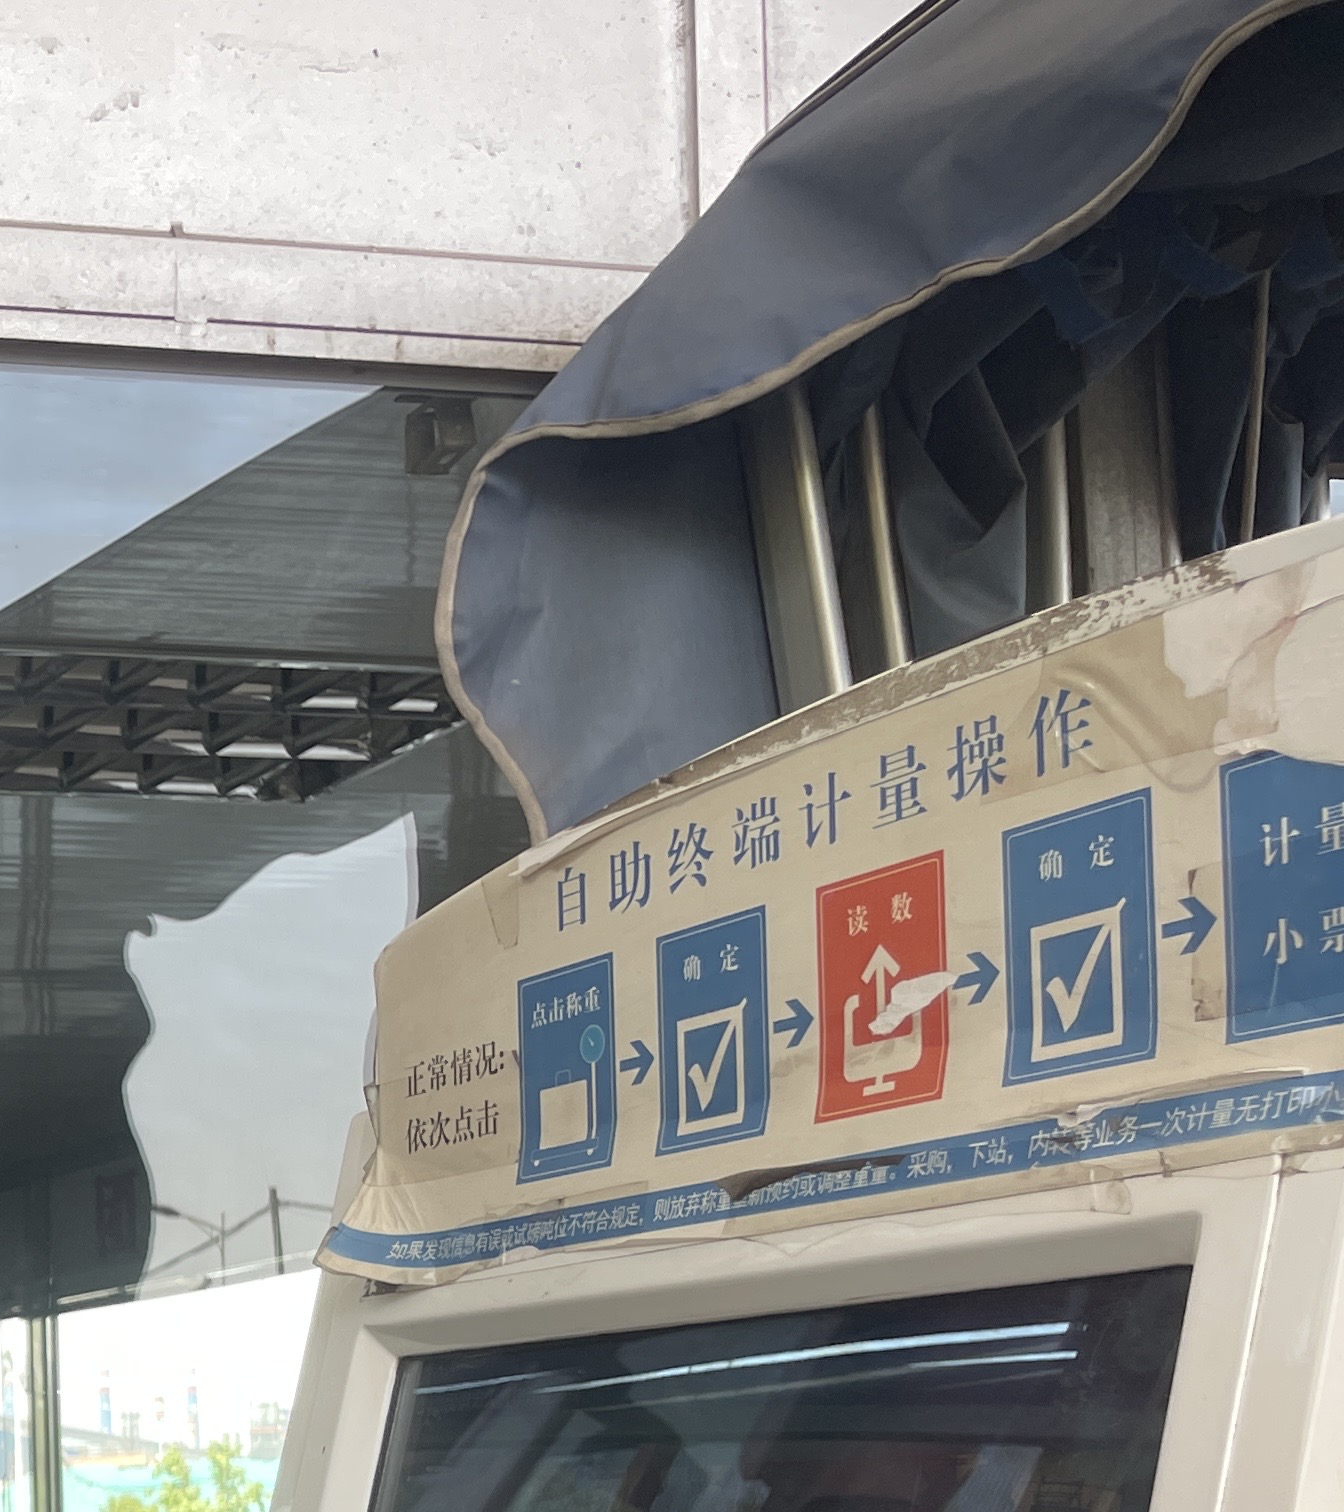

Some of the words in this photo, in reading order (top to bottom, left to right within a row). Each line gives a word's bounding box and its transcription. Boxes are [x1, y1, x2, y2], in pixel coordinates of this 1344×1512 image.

[556, 689, 1092, 931] 自助终端计量操作
[1038, 835, 1114, 881] 确定
[847, 891, 913, 936] 读数
[683, 944, 739, 981] 确定
[531, 986, 600, 1029] 点击称重
[405, 1041, 505, 1098] 正常情况：
[405, 1100, 499, 1154] 依次点击
